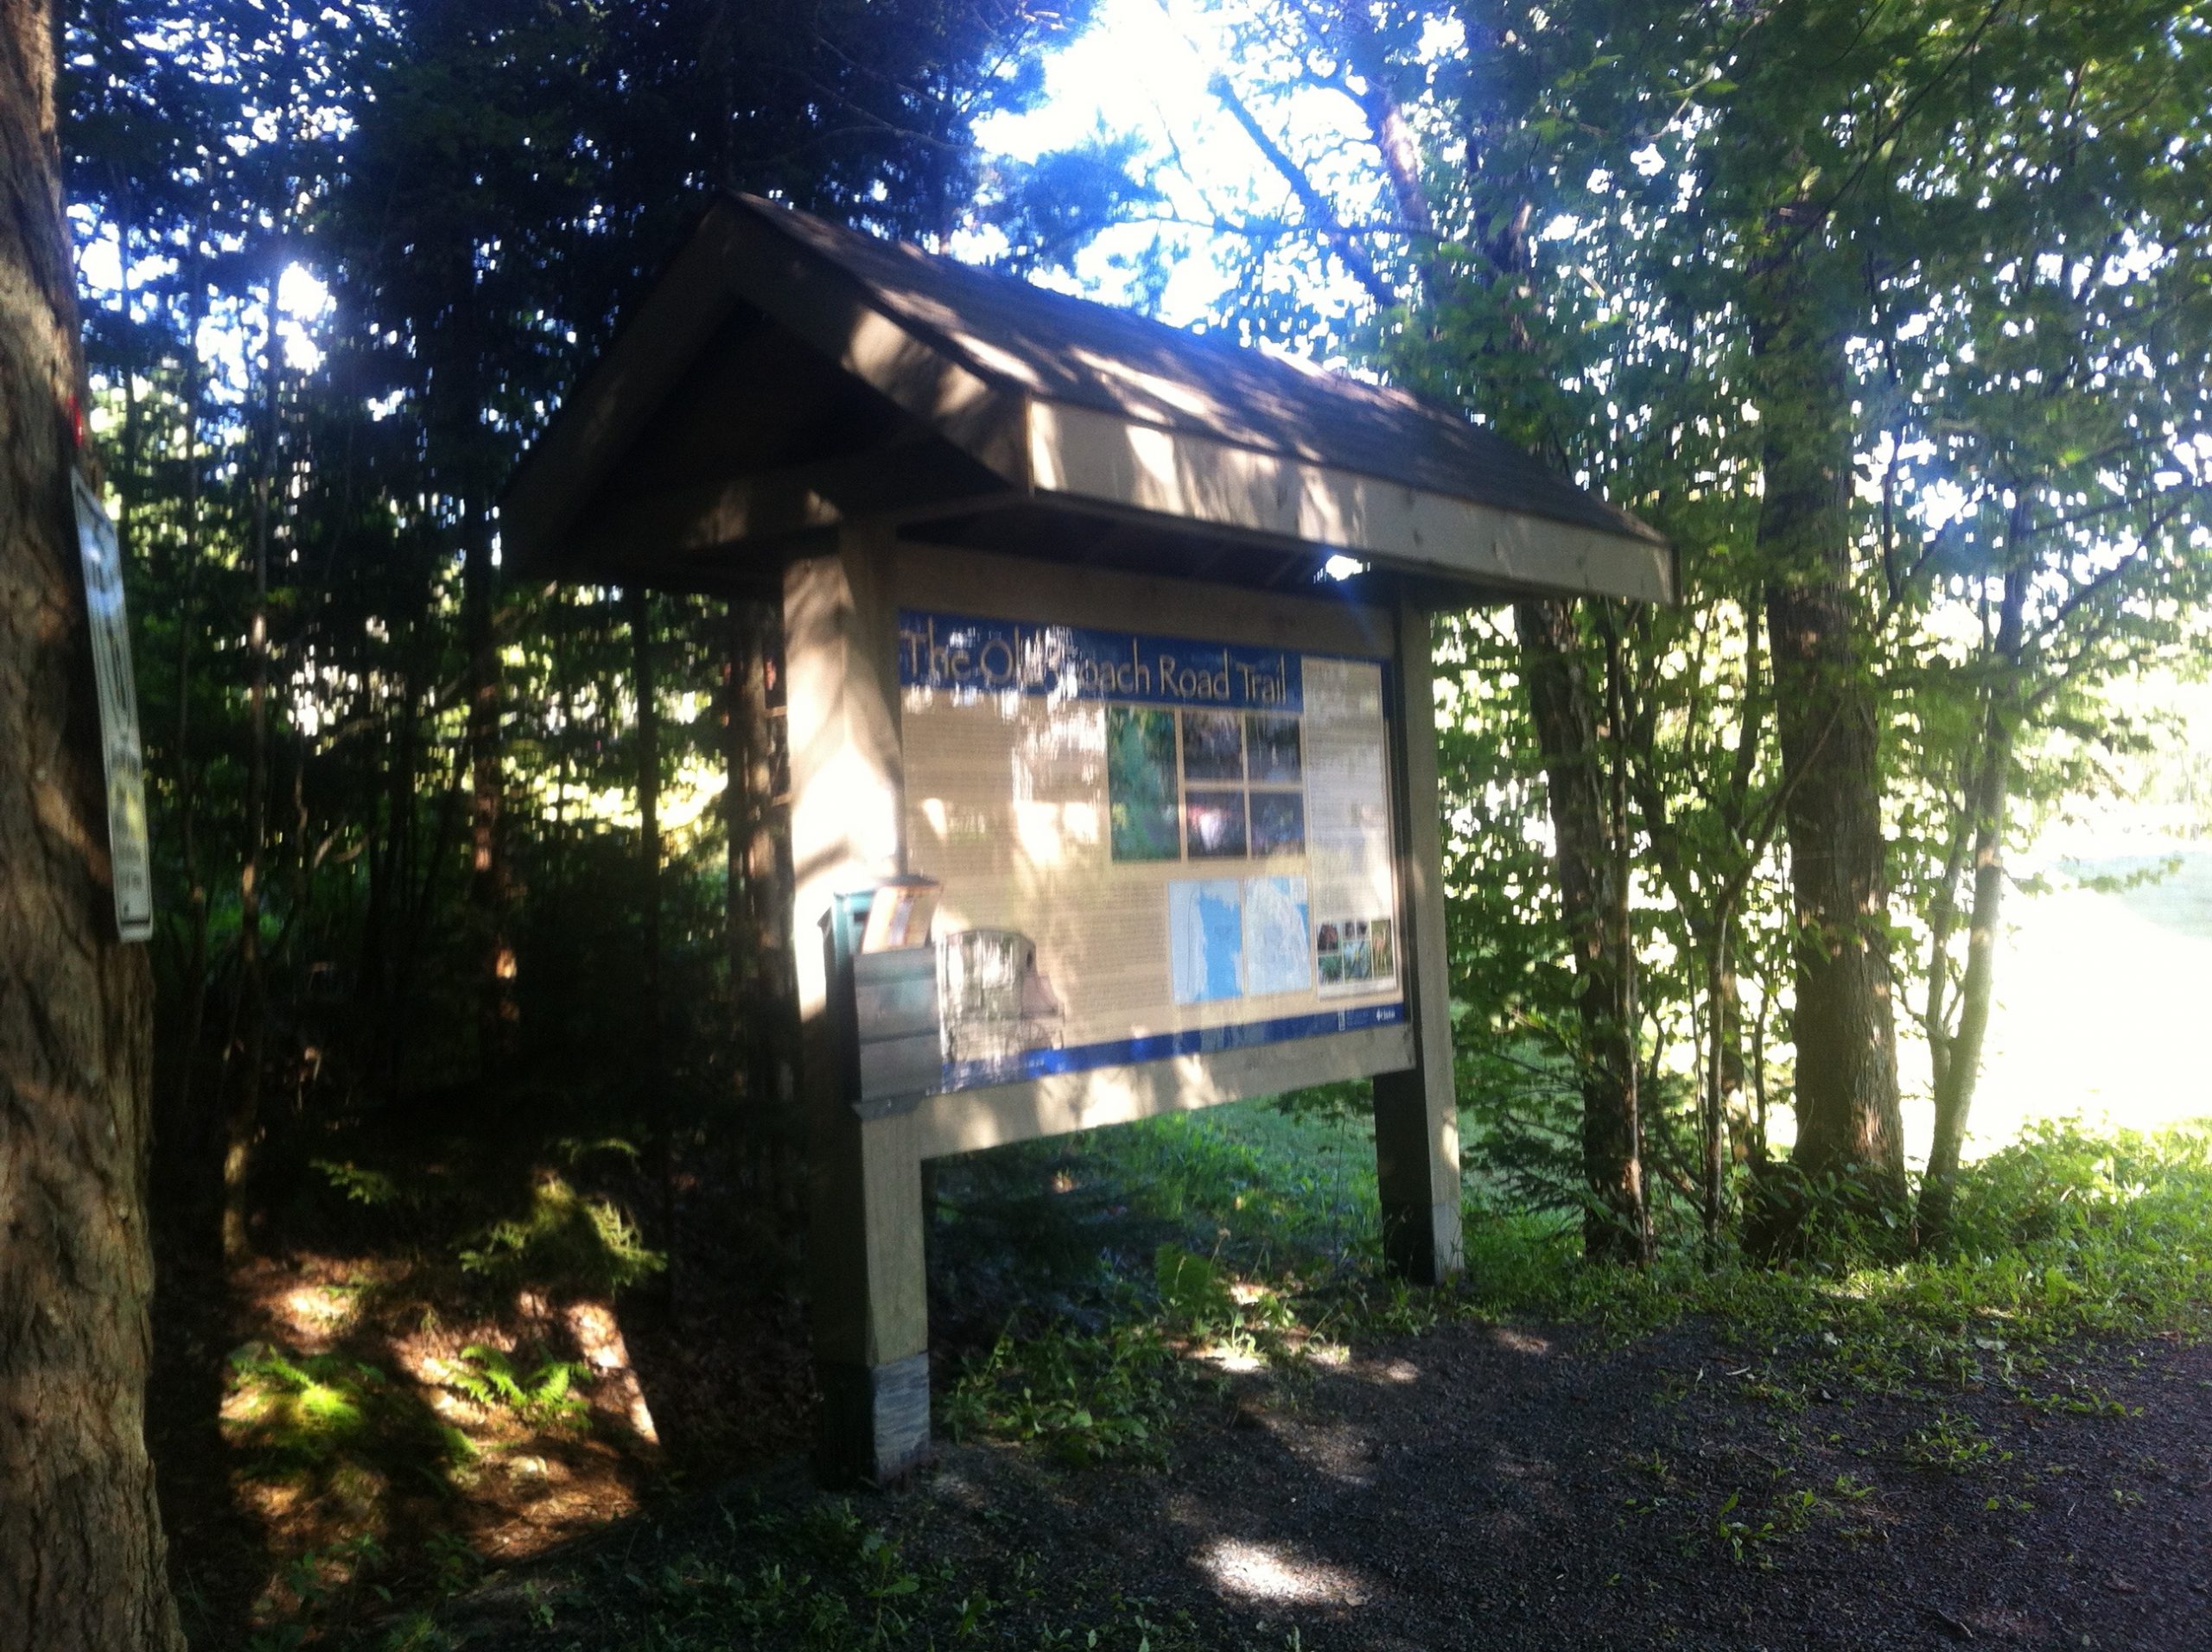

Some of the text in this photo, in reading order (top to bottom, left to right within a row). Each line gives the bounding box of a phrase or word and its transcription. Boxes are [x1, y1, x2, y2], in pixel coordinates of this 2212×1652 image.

[899, 616, 971, 681] The
[1160, 649, 1230, 702] Road
[1236, 653, 1287, 705] Trail
